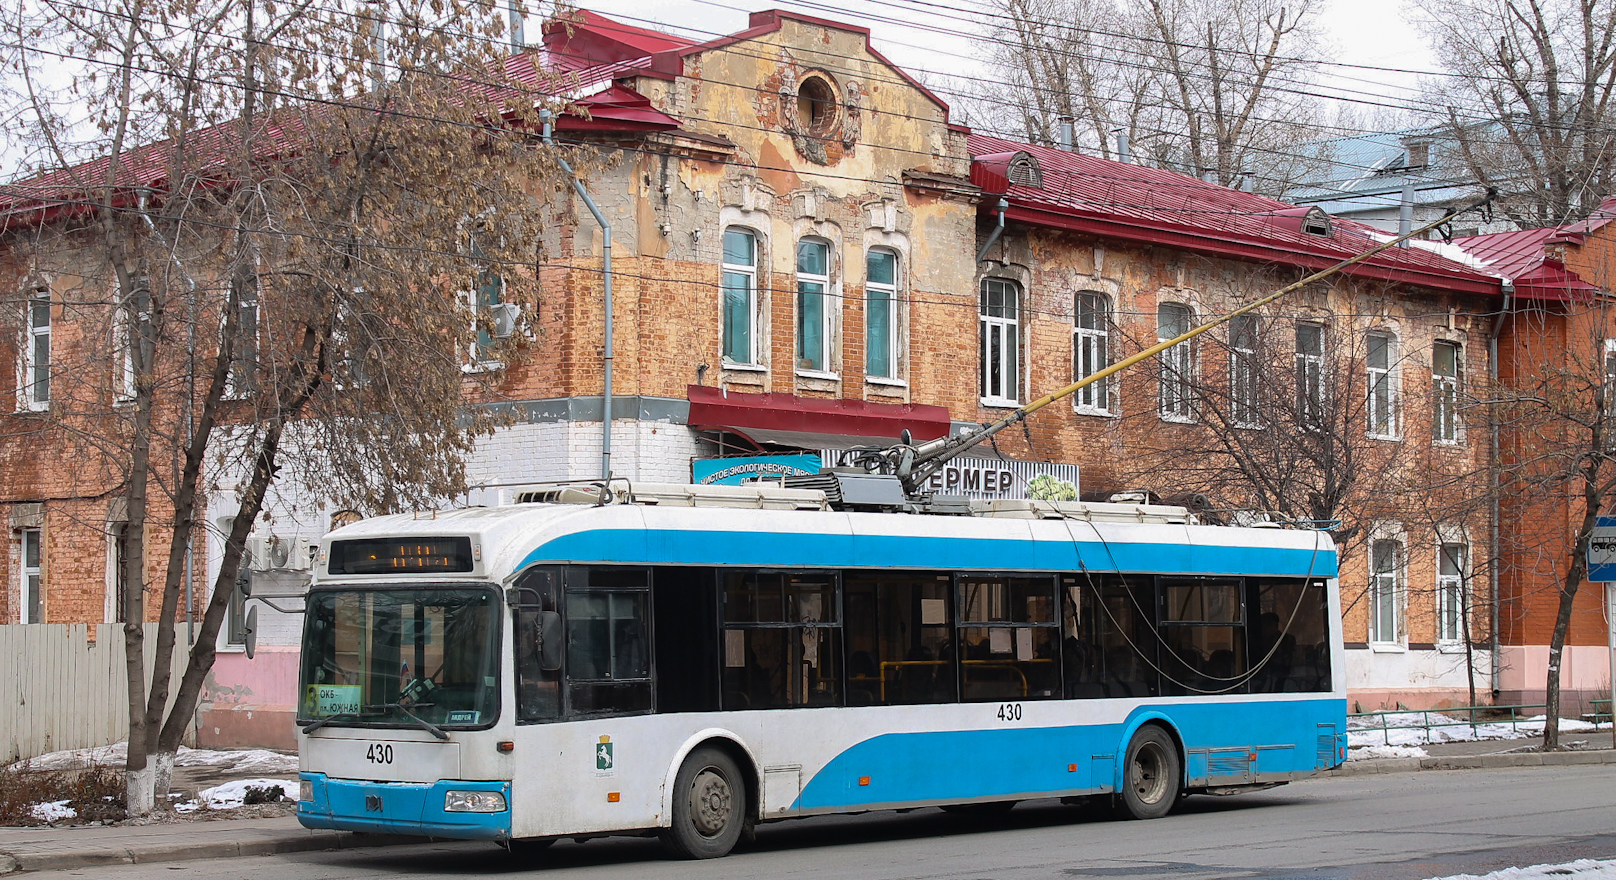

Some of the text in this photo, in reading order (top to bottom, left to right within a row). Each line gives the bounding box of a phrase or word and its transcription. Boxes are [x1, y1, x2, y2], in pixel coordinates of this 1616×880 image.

[700, 469, 729, 486] ЧИСТОЕ
[729, 463, 793, 477] ЭКОЛОГИЧЕСКОЕ
[926, 466, 1014, 494] ЕРМЕР
[308, 687, 317, 713] 3
[329, 703, 359, 713] ЮЖНАЯ
[997, 703, 1022, 721] 430
[366, 743, 394, 765] 430
